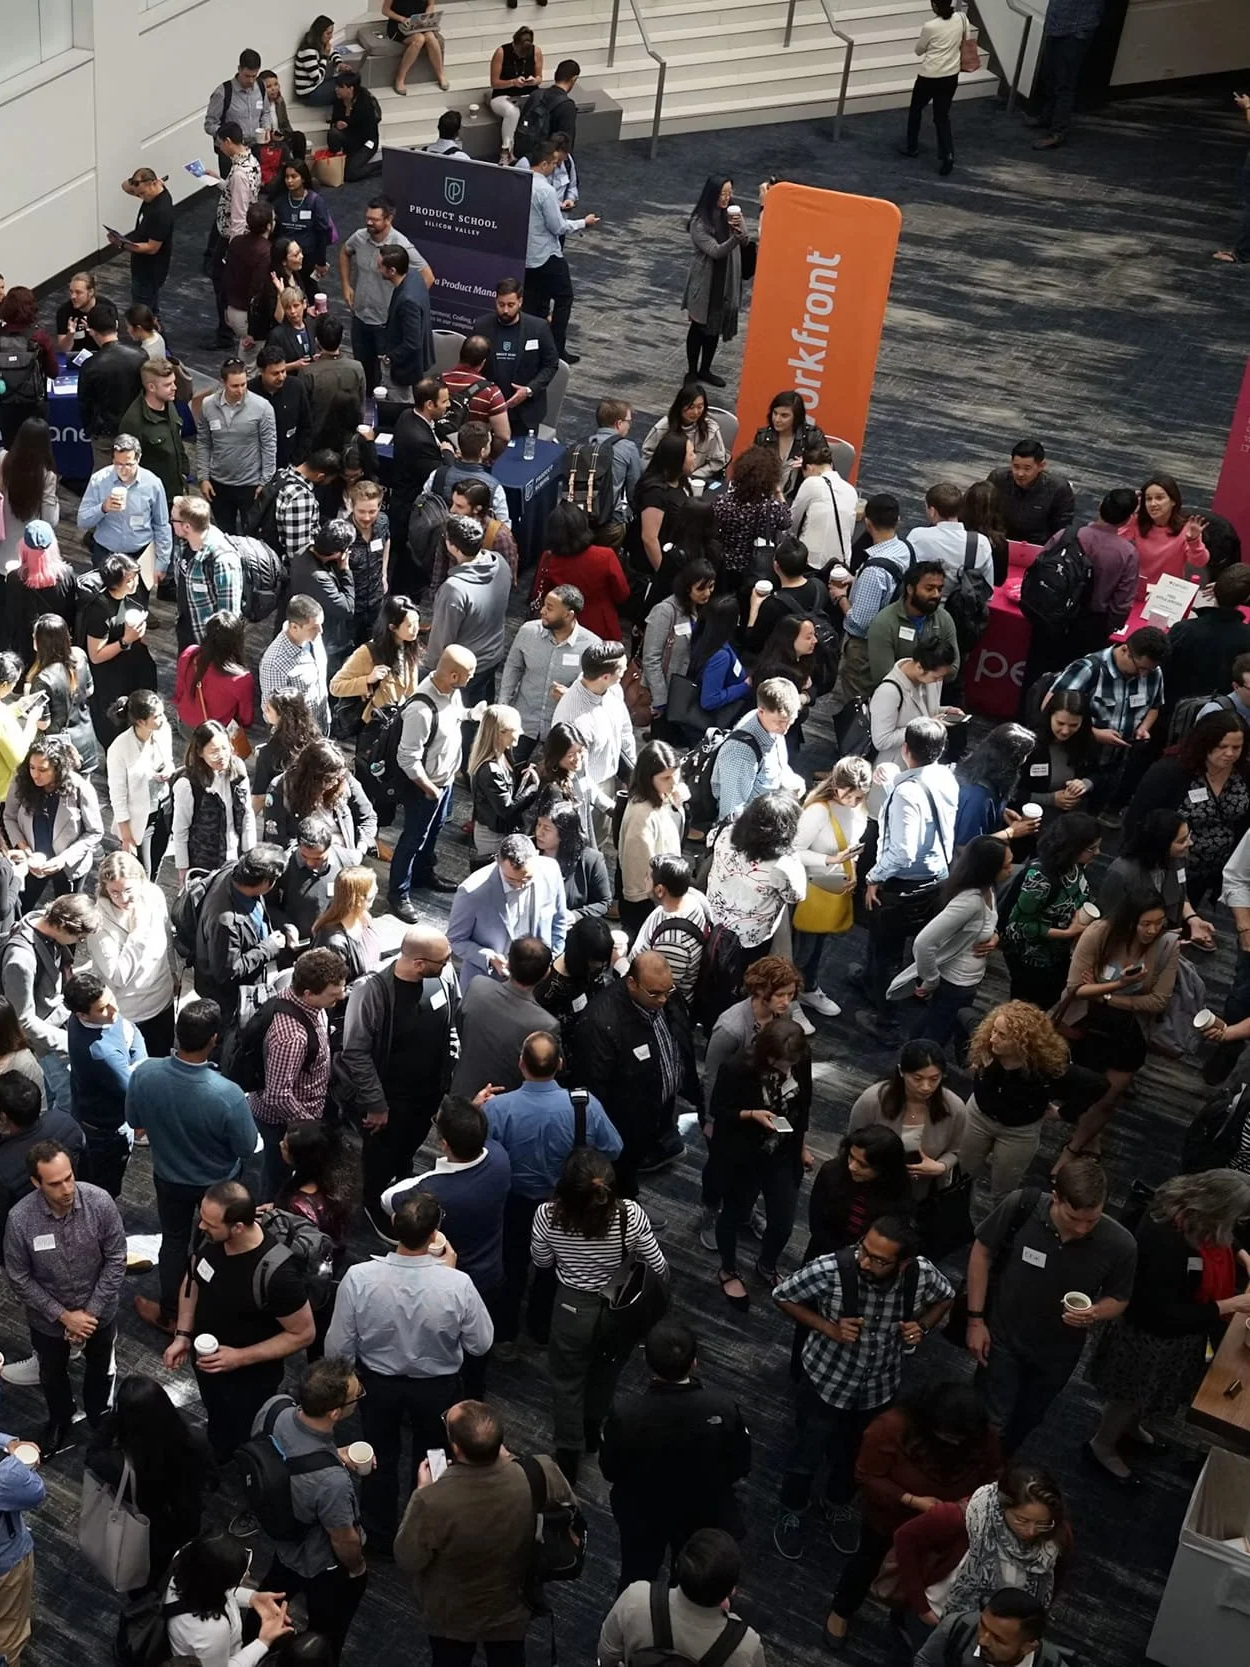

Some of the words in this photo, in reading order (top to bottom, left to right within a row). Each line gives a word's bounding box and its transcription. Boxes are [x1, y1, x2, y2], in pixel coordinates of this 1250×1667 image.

[409, 204, 455, 221] PRODUCT
[458, 214, 498, 229] SCHOOL
[425, 220, 452, 231] SILICON
[455, 227, 480, 236] VALLEY
[441, 279, 471, 293] Product
[472, 286, 497, 298] Mana
